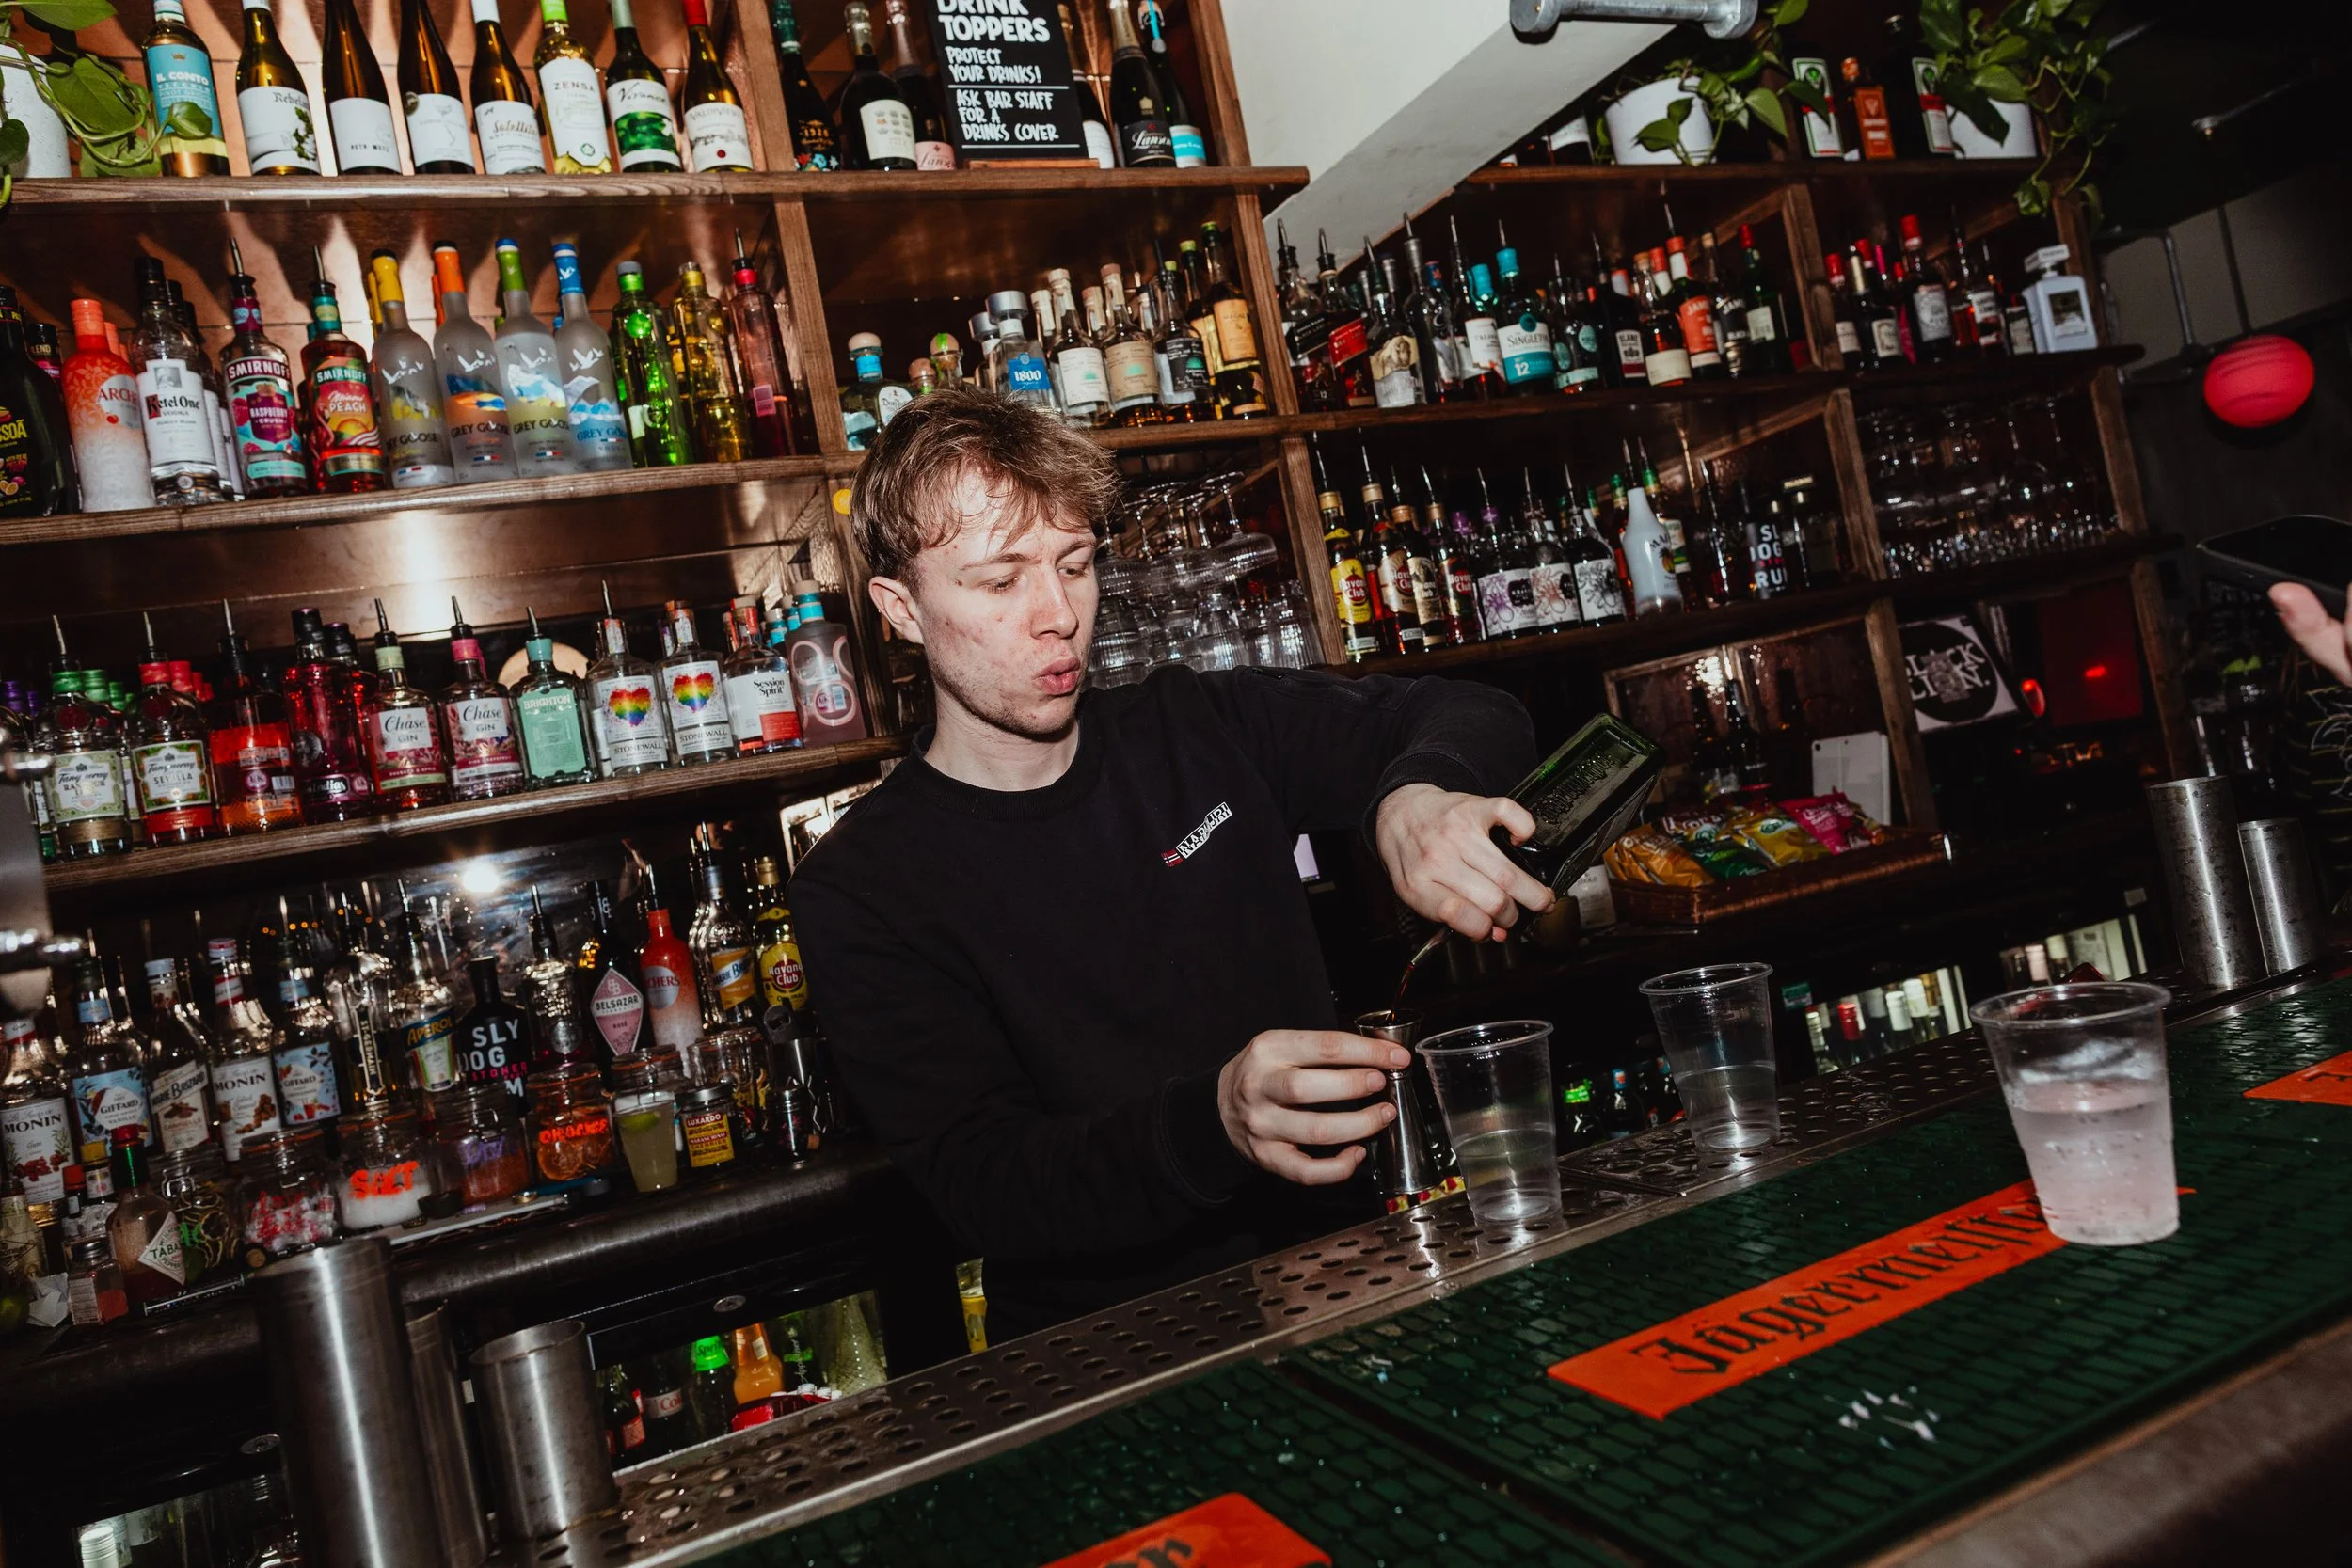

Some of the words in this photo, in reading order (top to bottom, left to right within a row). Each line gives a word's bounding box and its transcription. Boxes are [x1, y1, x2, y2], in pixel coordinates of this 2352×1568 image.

[938, 14, 1050, 42] TOPPERS
[945, 46, 1002, 65] PROTECT
[167, 71, 210, 86] CONTO
[948, 64, 986, 83] YOUR
[986, 65, 1041, 83] DRINKS!
[956, 89, 982, 107] ASK
[984, 90, 1013, 109] BAR
[1014, 91, 1054, 110] STAFF
[958, 107, 987, 123] FOR
[991, 108, 1001, 124] A
[961, 123, 1009, 142] DRINKS
[1014, 123, 1059, 141] COVER
[1014, 370, 1041, 382] 1800
[1514, 361, 1531, 377] 12
[179, 395, 200, 410] One
[329, 402, 367, 413] PEACH
[249, 407, 288, 418] RASPBERRY
[753, 678, 785, 689] Session
[758, 687, 783, 698] Spirit
[523, 694, 571, 709] BRIGHTON
[540, 705, 557, 713] GIN
[462, 705, 503, 721] Chase
[384, 714, 427, 733] Chase
[475, 722, 496, 733] GIN
[398, 733, 419, 744] GIN
[679, 728, 728, 743] STONEWALL
[776, 973, 799, 986] Club
[595, 994, 640, 1011] BELSAZAR
[471, 1017, 519, 1048] SLY
[213, 1072, 266, 1092] MONIN
[100, 1099, 139, 1115] GIFFARD
[3, 1113, 63, 1133] MONIN
[687, 1113, 722, 1127] LUXARDO
